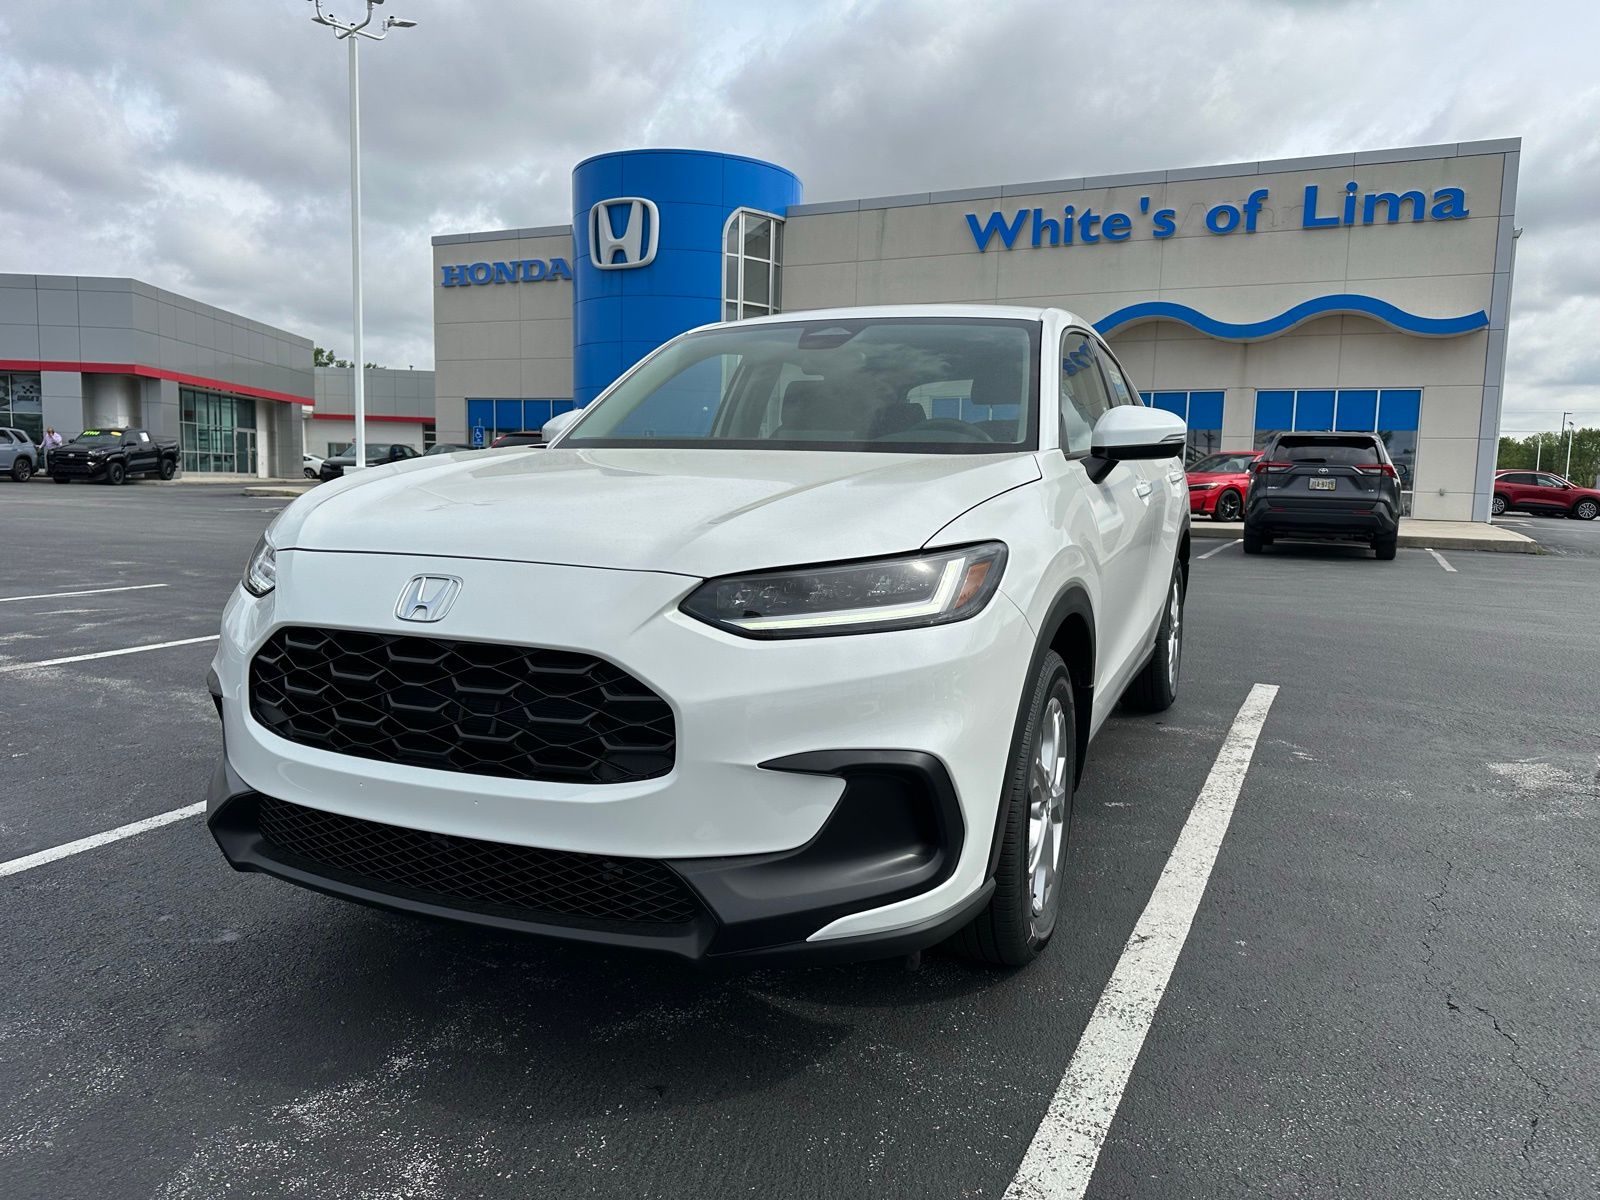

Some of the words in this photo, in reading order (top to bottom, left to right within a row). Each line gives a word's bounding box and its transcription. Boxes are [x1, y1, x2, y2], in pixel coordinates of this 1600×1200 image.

[965, 196, 1177, 253] White's
[1205, 188, 1269, 234] of
[1302, 181, 1470, 229] Lima
[441, 258, 572, 287] HONDA
